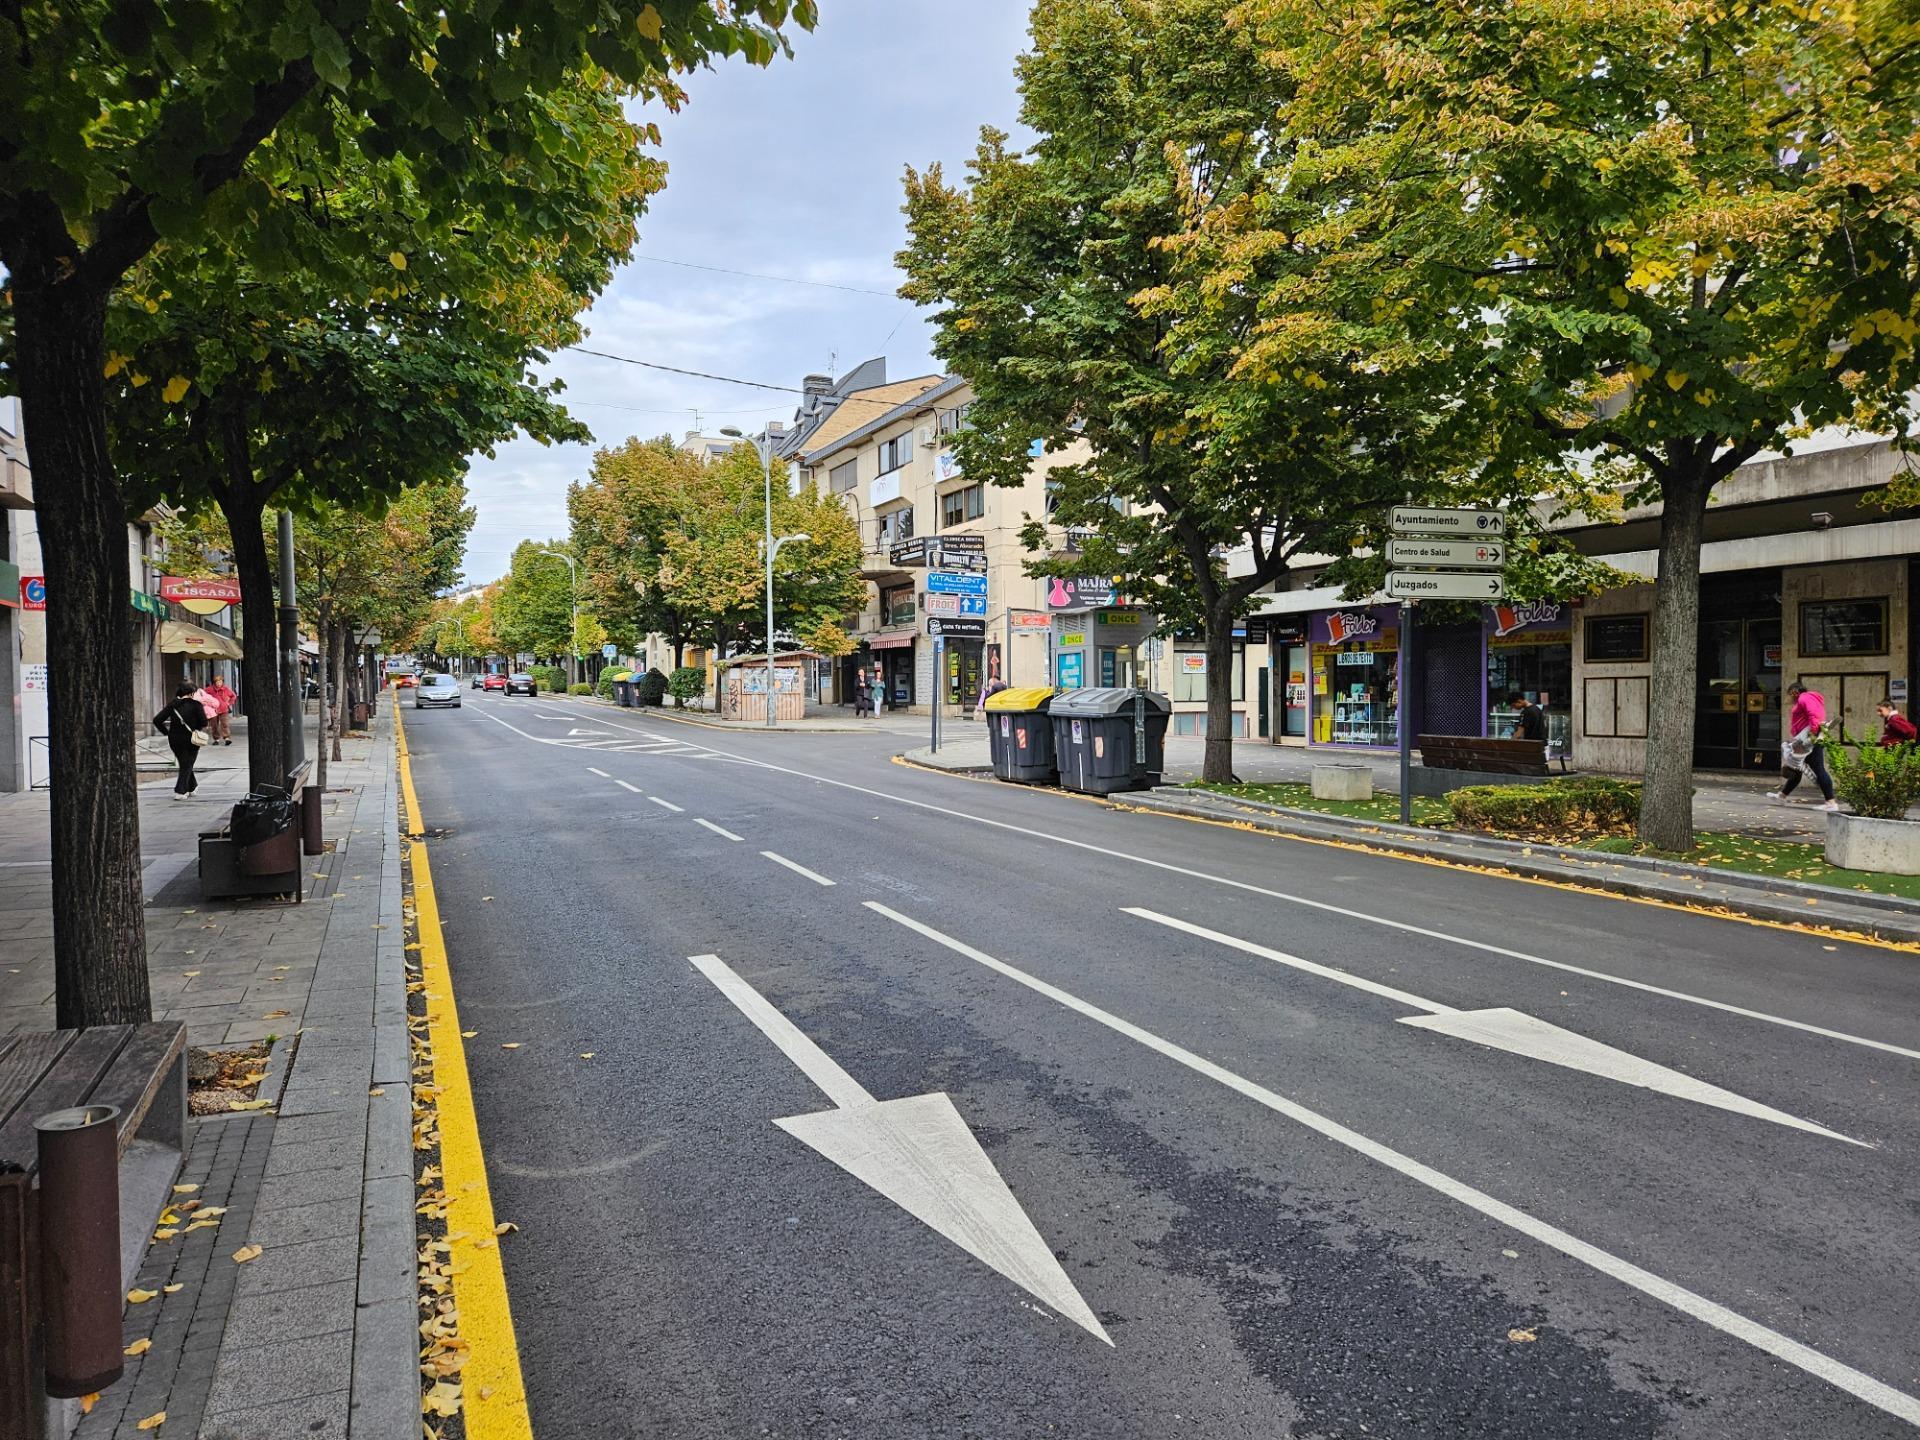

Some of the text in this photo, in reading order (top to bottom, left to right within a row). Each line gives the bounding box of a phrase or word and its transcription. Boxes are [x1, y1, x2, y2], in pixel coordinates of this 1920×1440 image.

[1395, 514, 1459, 526] Ayuntamiento
[1394, 547, 1450, 557] Centro de Salud
[930, 574, 982, 584] VITALDENT
[1394, 580, 1438, 591] Juzgados
[930, 600, 956, 609] FROIZ
[1110, 615, 1136, 623] ONCE
[1341, 613, 1376, 634] Folder
[1067, 634, 1083, 643] ONCE
[1338, 653, 1353, 665] LIBROS
[1358, 652, 1373, 664] TEXTO
